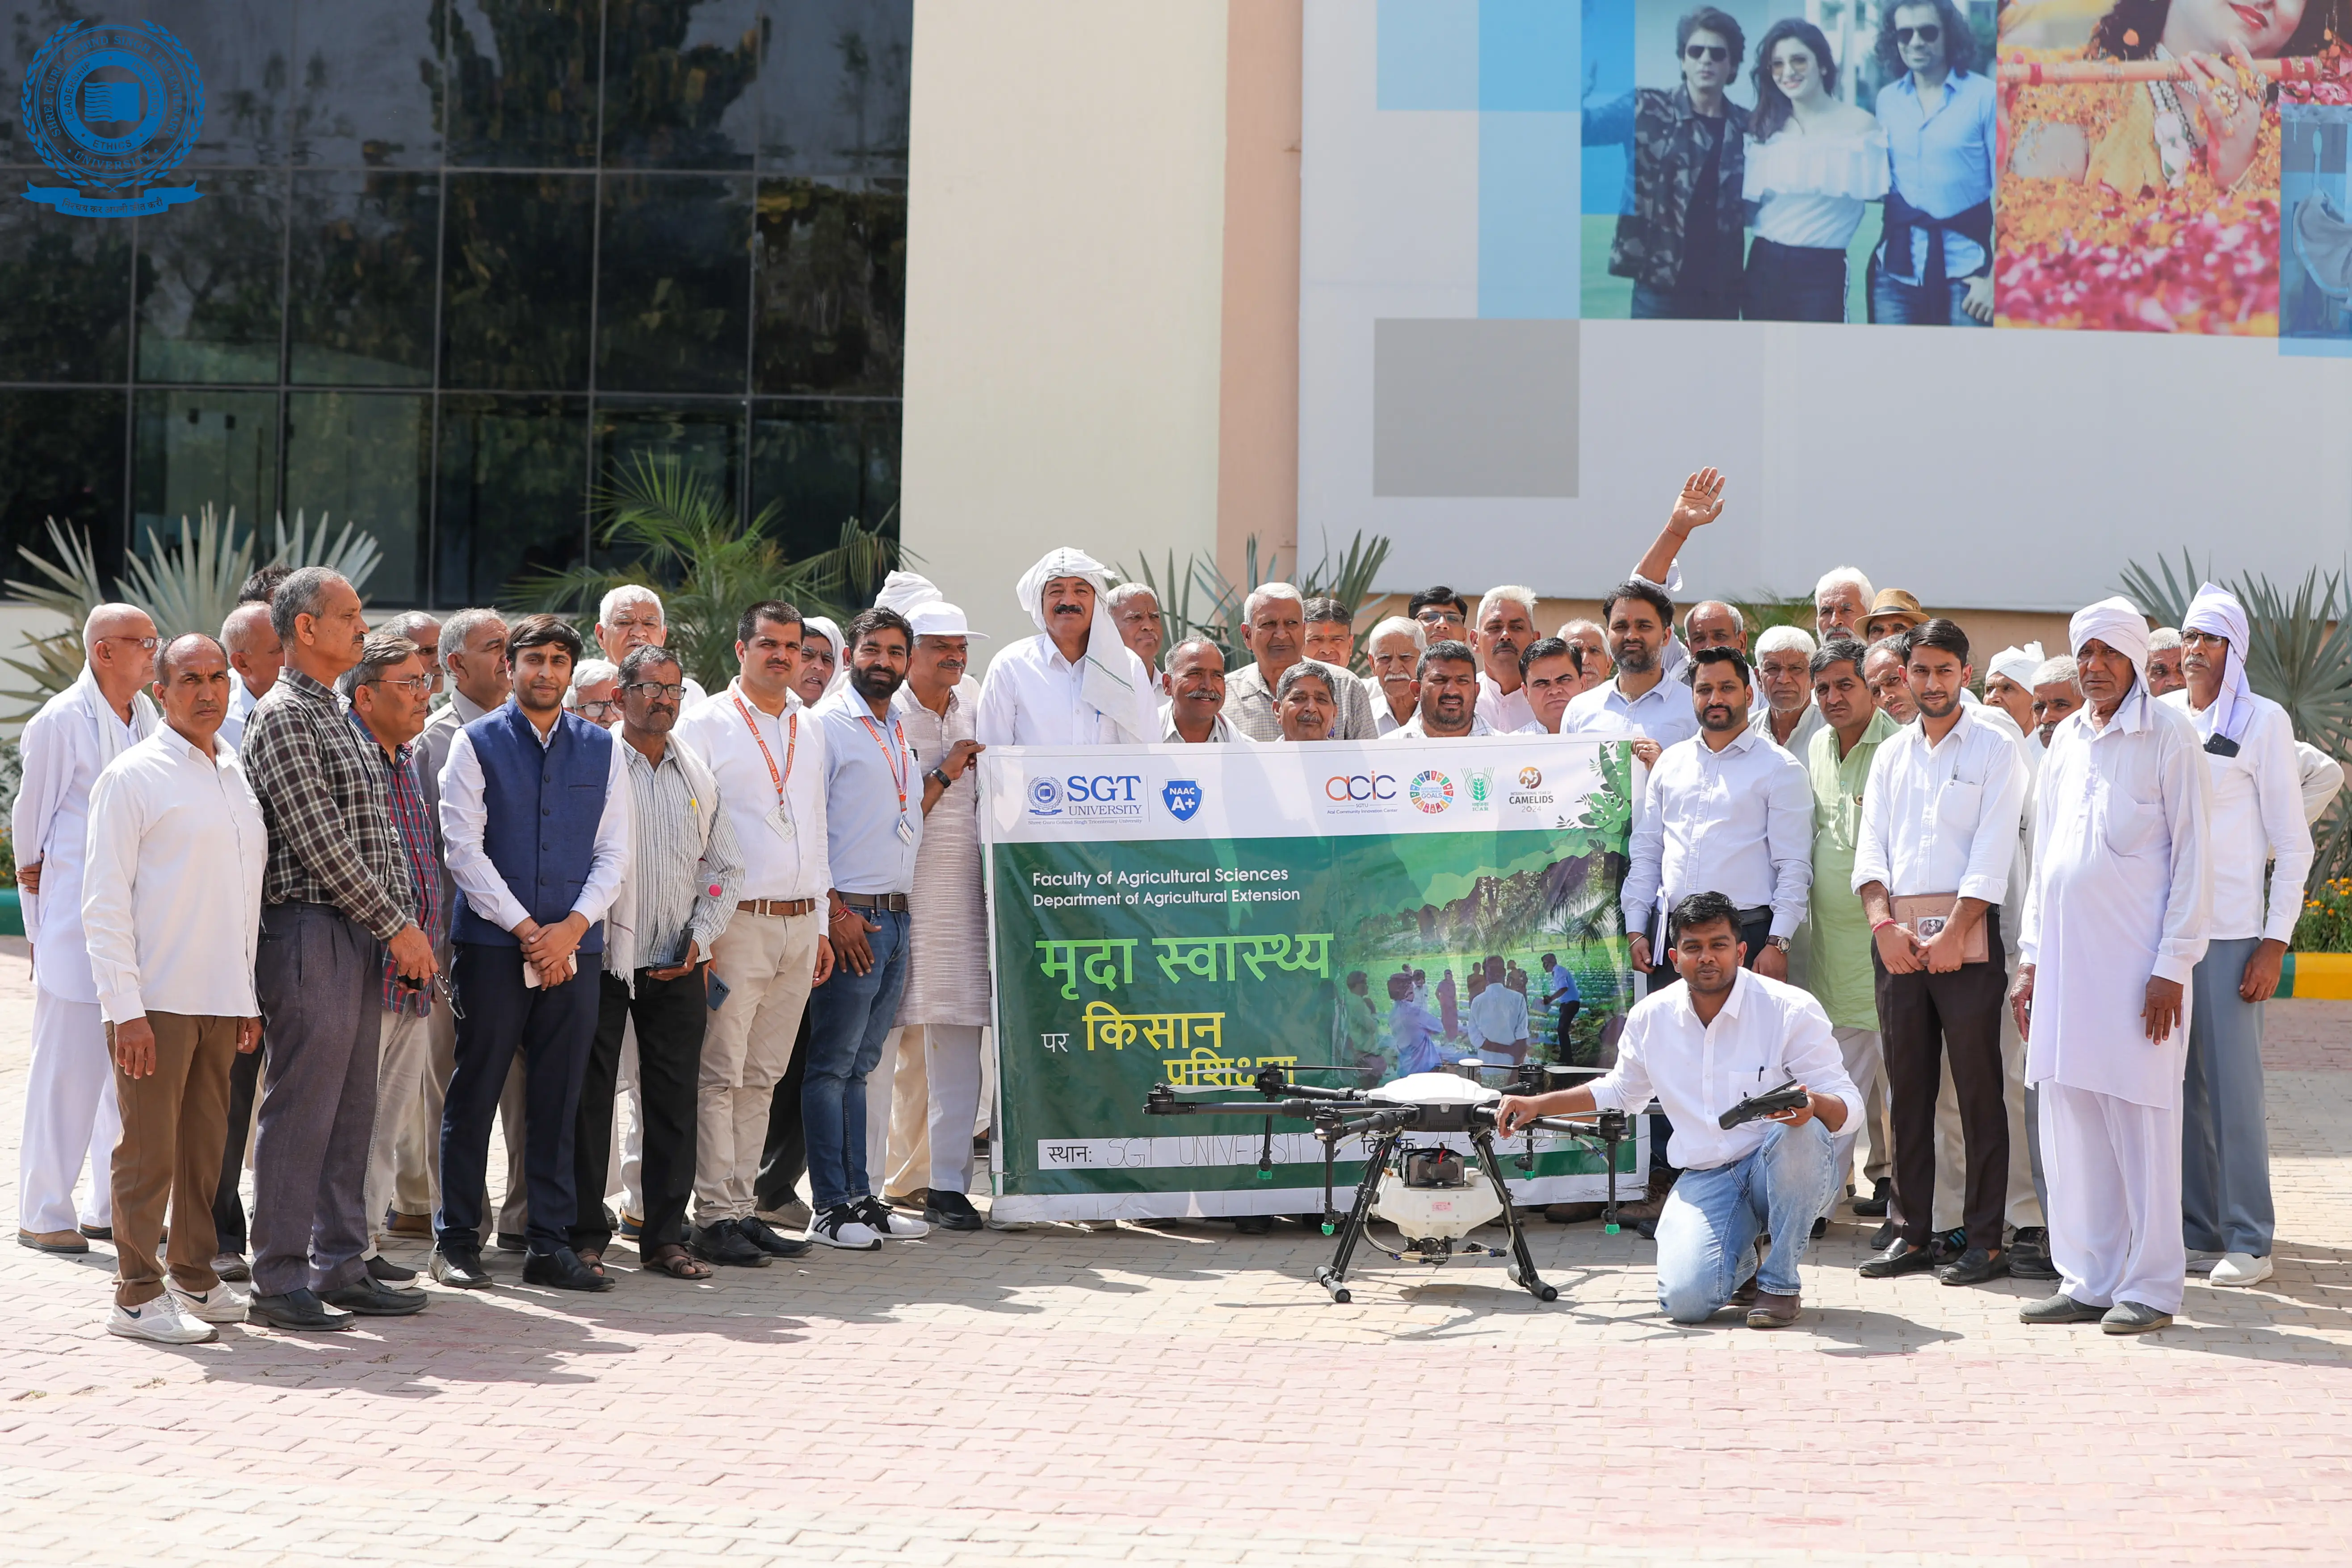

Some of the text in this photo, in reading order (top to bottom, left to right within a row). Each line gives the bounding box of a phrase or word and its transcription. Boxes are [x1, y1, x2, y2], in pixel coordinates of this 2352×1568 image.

[735, 700, 751, 724] UNIVERSITY
[760, 742, 775, 770] UNIVERSITY
[1067, 775, 1141, 802] SGT
[1169, 787, 1195, 795] NAAC
[1326, 770, 1397, 801] acic
[1069, 805, 1142, 816] UNIVERSITY
[1171, 796, 1195, 811] A+
[1509, 795, 1554, 804] CAMELIDS
[1033, 867, 1288, 888] Faculty of Agricultural Sciences
[1033, 888, 1300, 908] Department of Agricultural Extension
[1036, 933, 1334, 1000] मृदा स्वास्थ्य
[1041, 1001, 1225, 1053] पर किसान
[1047, 1146, 1092, 1163] स्थान:
[1107, 1138, 1158, 1167] SGT
